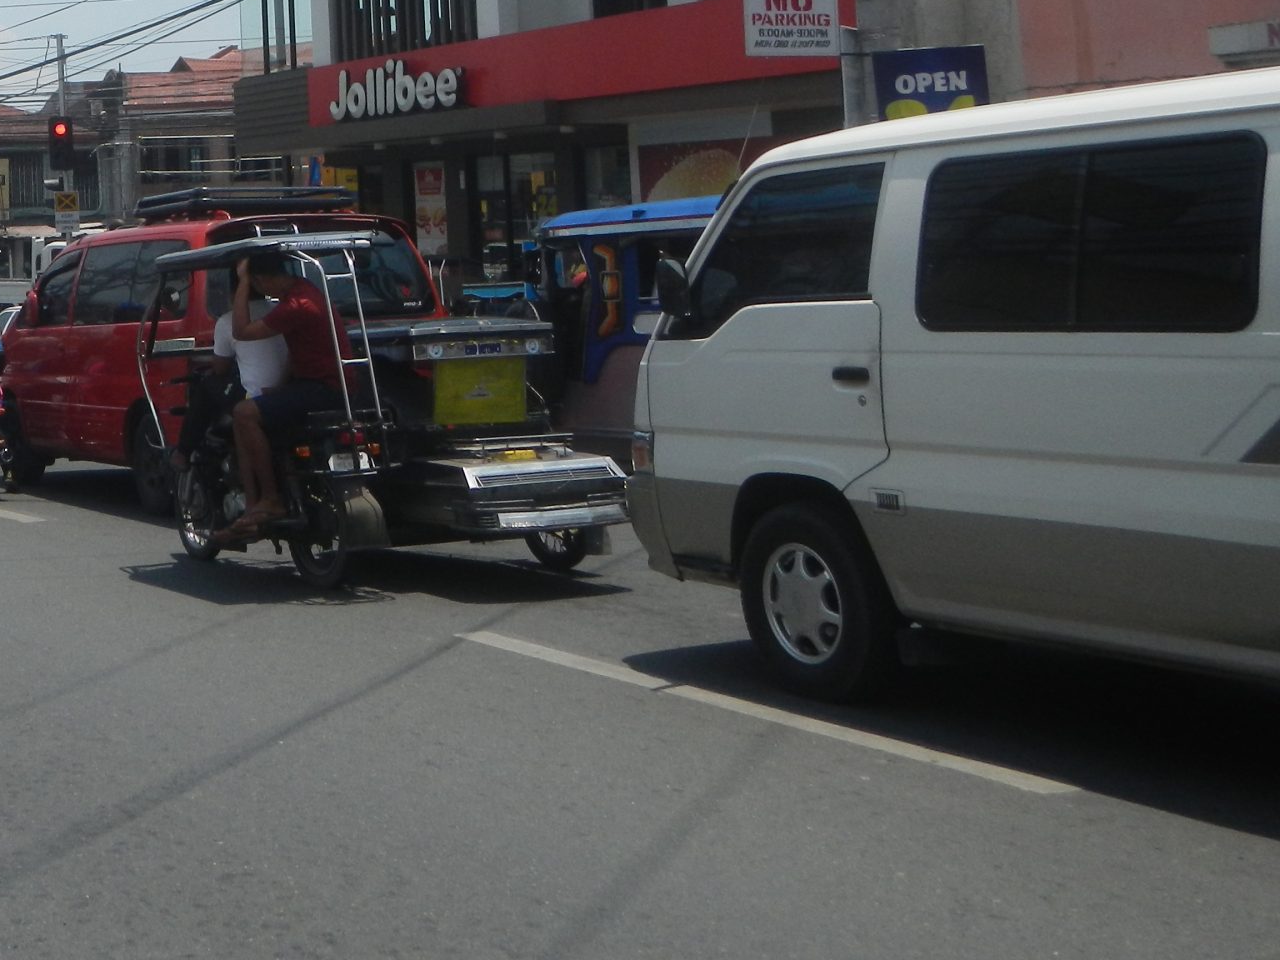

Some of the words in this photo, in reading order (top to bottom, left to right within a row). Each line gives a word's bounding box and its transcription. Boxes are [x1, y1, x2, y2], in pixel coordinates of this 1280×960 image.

[752, 13, 831, 27] PARKING
[330, 59, 458, 121] Jollibee
[895, 70, 968, 95] OPEN
